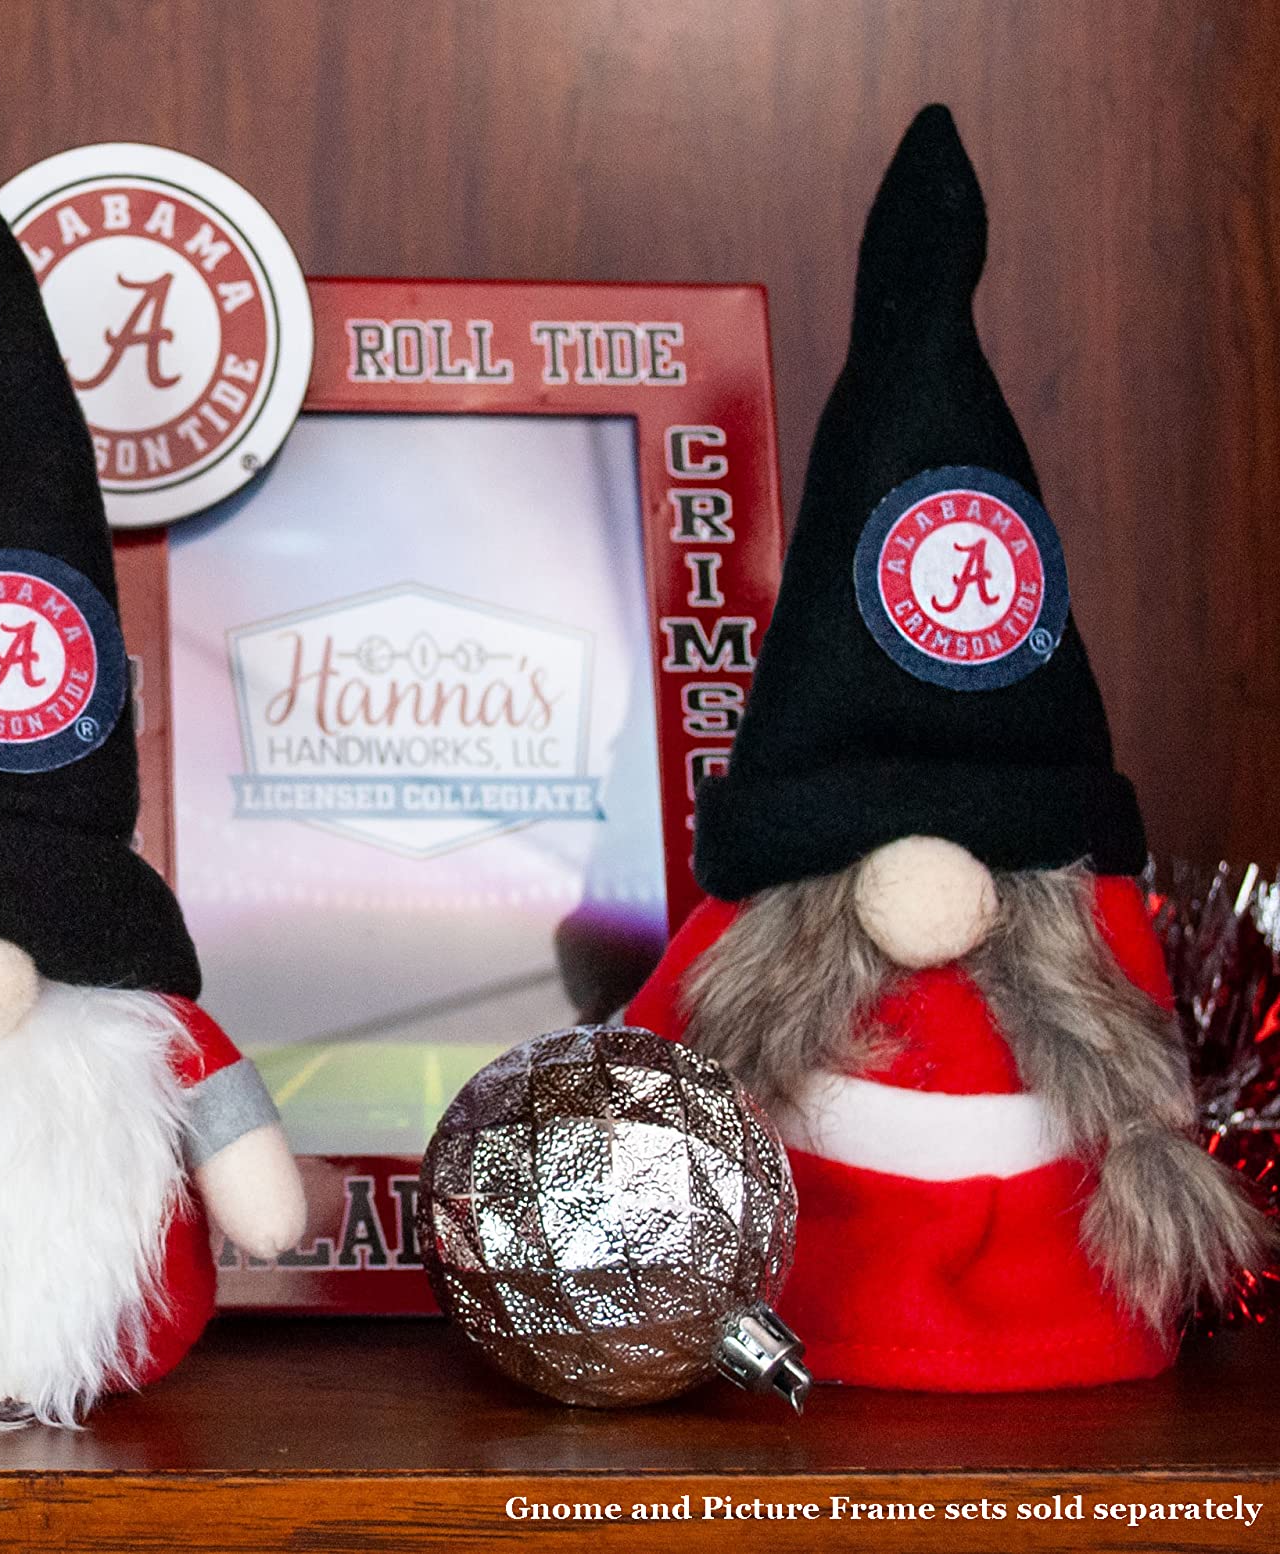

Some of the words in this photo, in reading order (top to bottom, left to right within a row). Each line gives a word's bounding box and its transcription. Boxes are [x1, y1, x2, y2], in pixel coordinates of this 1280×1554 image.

[21, 194, 257, 313] LABAMA
[346, 318, 514, 384] ROLL
[531, 320, 687, 386] TIDE
[177, 353, 259, 453] TIDE
[887, 500, 1029, 576] ALABAMA
[931, 538, 1001, 613] A
[659, 424, 758, 832] CRIMS
[894, 598, 1003, 656] CRIMSON
[1002, 580, 1040, 638] TIDE
[45, 667, 90, 722] TIDE
[265, 630, 566, 736] Hanna's
[513, 737, 561, 768] LLC
[242, 783, 397, 811] LICENSED
[402, 783, 594, 812] COLLEGIATE
